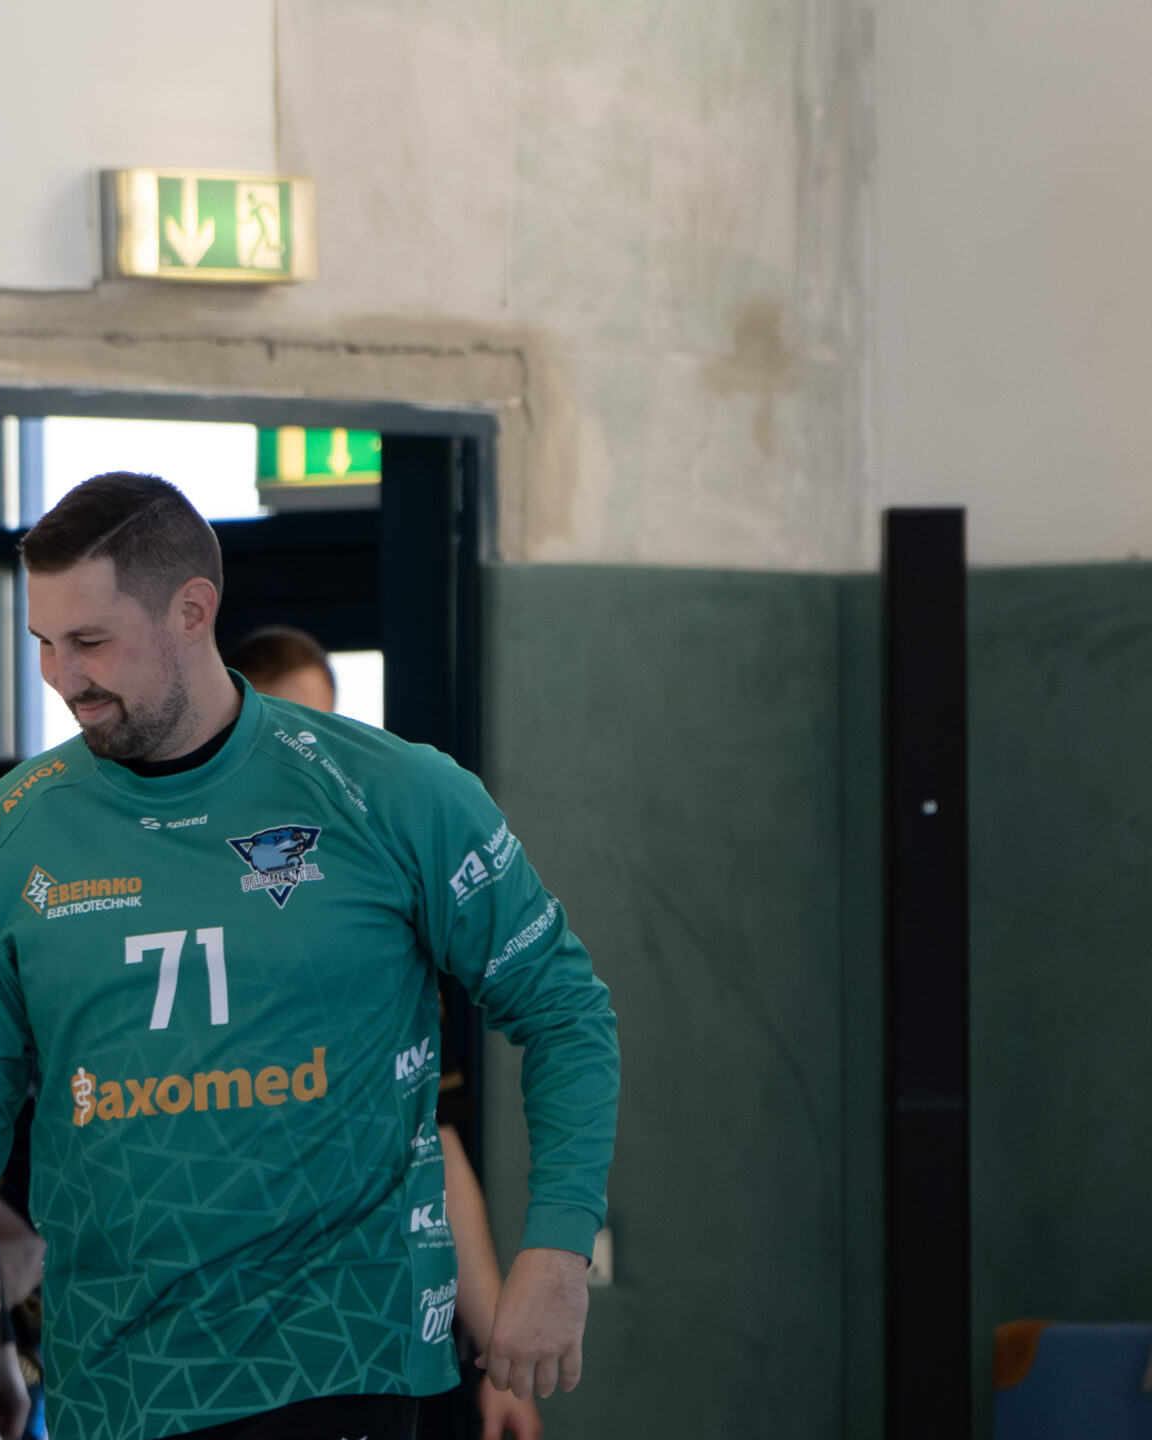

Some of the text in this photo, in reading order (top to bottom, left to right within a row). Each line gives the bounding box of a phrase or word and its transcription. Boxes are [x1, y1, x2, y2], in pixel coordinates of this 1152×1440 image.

[273, 728, 317, 761] ZURICH
[47, 877, 143, 906] EBEHAKO
[46, 896, 143, 919] ELEKTROTECHNIK
[124, 926, 229, 1030] 71
